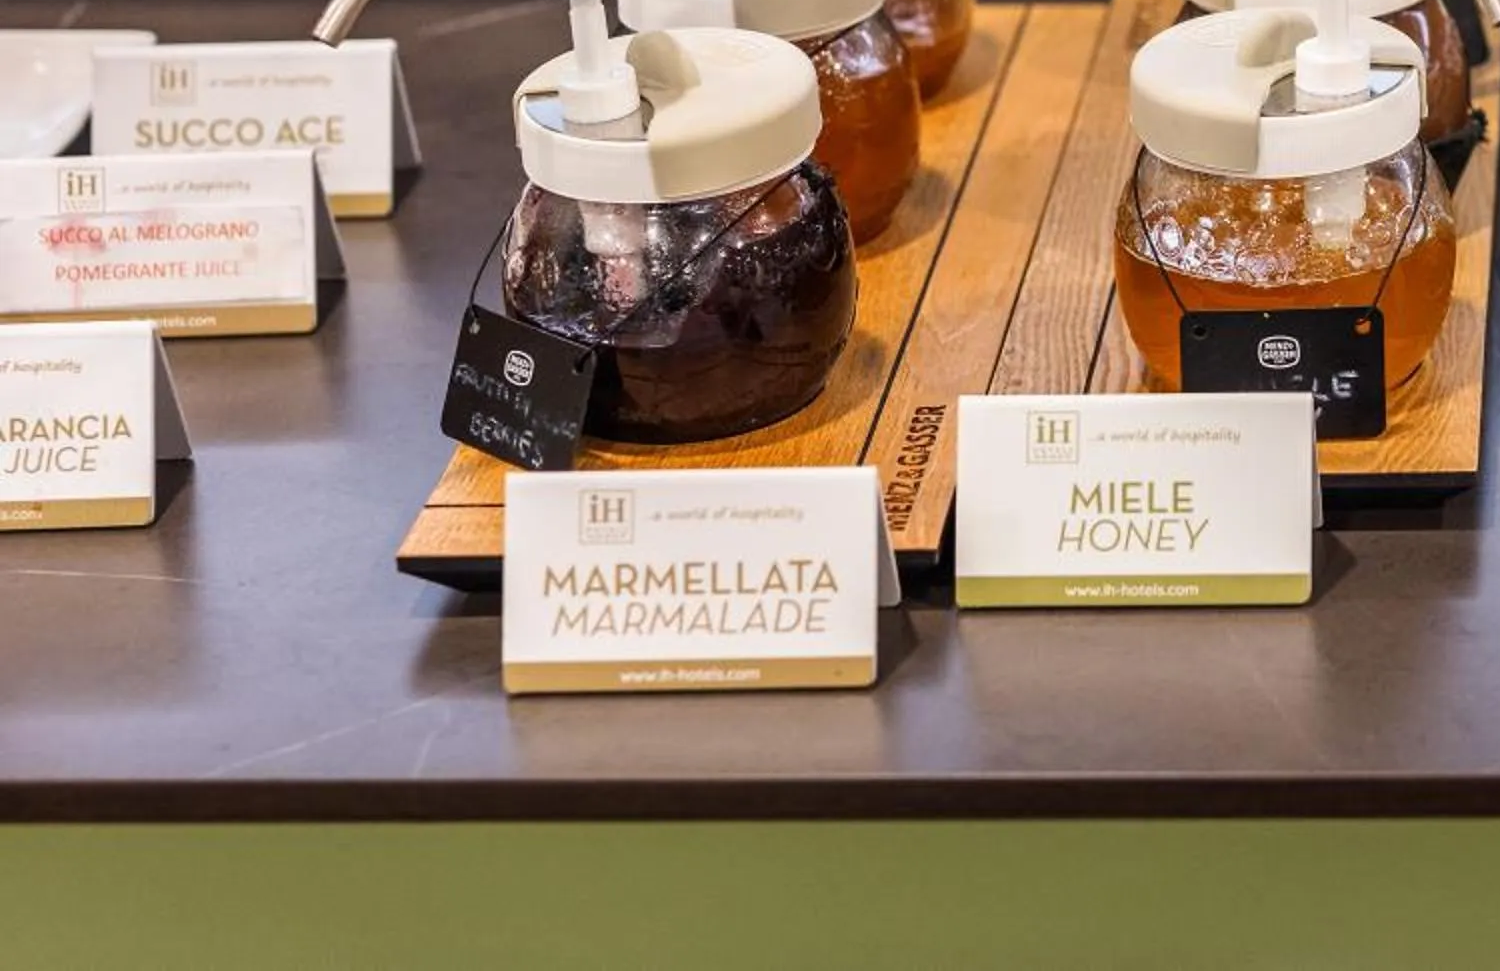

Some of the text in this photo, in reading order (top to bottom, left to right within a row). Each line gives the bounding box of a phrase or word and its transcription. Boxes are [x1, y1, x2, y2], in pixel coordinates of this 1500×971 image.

[135, 115, 345, 148] SUCCO ACE
[38, 221, 260, 245] SUCCO AL MELOGRANO
[55, 262, 188, 282] POMEGRANTE
[1036, 416, 1071, 444] iH
[4, 445, 99, 474] JUICE
[589, 494, 627, 523] iH
[1070, 481, 1195, 514] MIELE
[1057, 518, 1209, 552] HONEY
[543, 559, 839, 597] MARMELLATA
[1065, 583, 1199, 598] www.ih-hotels.com
[551, 598, 832, 637] MARMALADE
